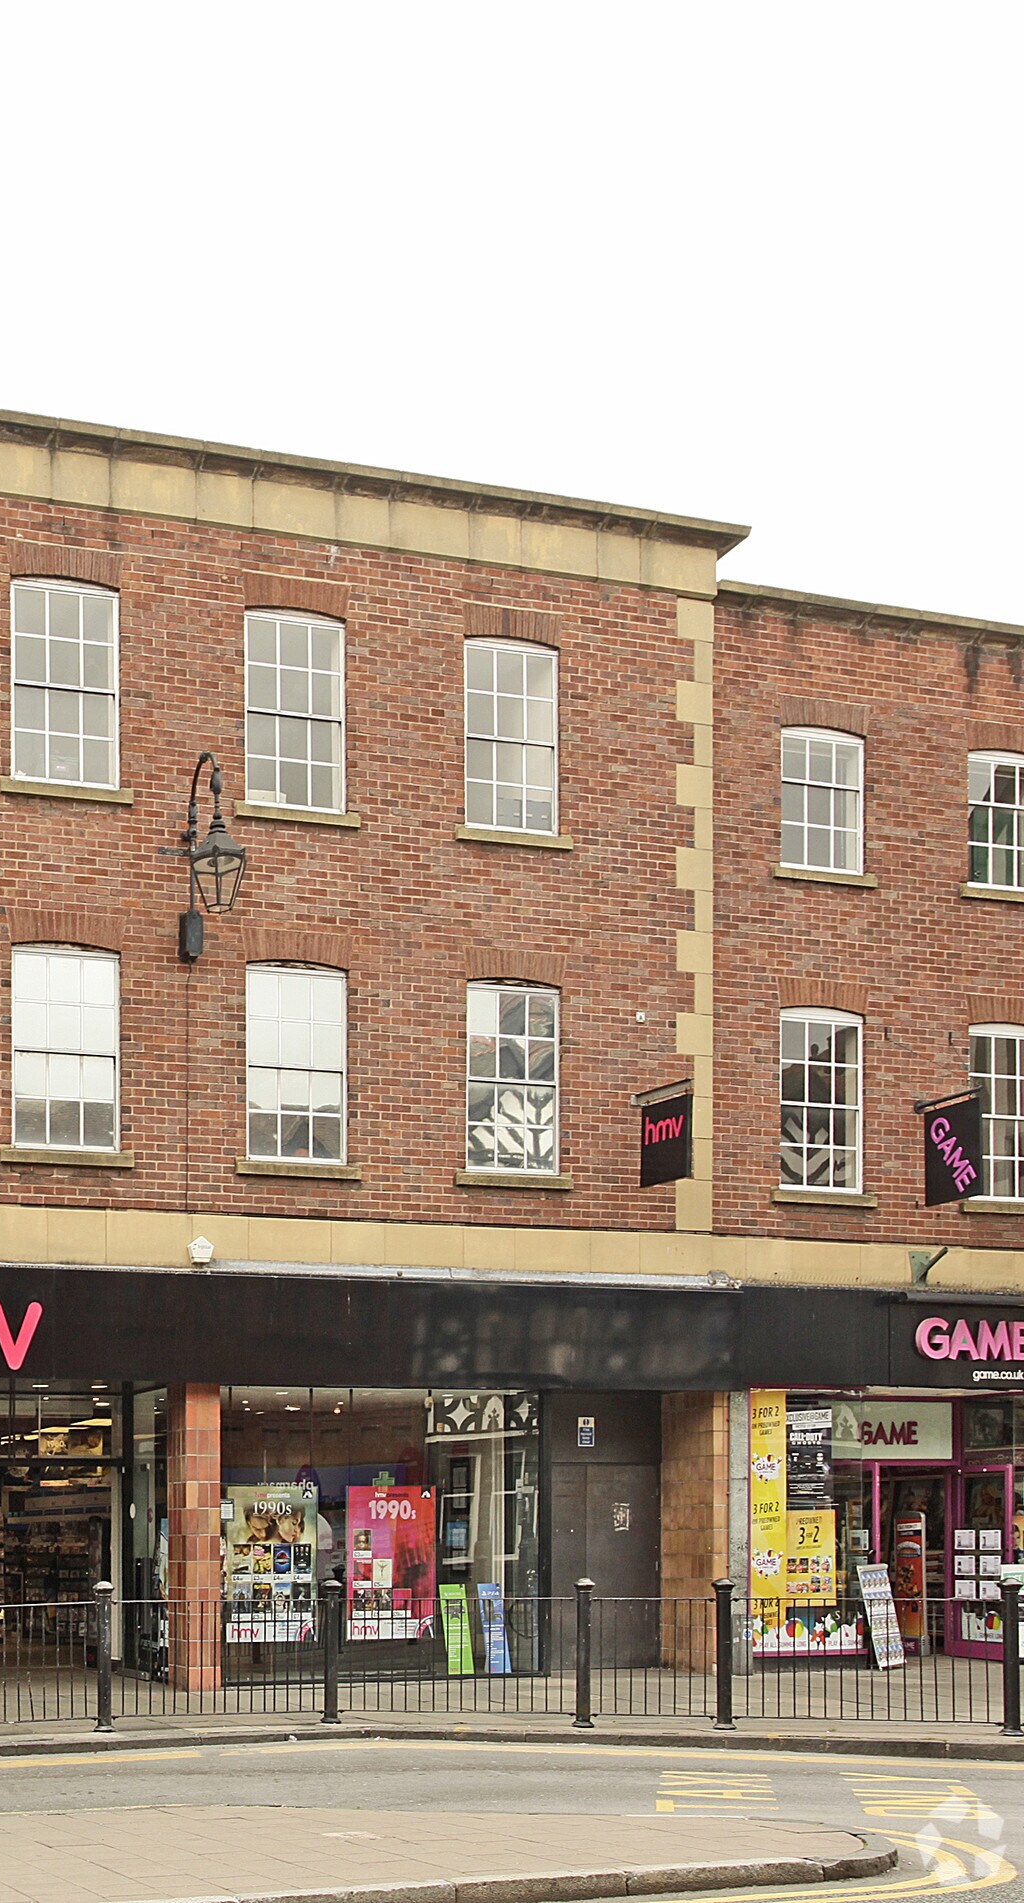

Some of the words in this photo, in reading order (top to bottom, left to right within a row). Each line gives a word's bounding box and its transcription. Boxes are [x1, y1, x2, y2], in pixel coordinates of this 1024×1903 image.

[645, 1114, 684, 1145] hmv
[930, 1117, 977, 1193] GAME
[915, 1317, 1024, 1360] GAME
[972, 1370, 1024, 1382] game.co.uk
[752, 1409, 757, 1419] 3
[759, 1407, 773, 1418] FOR
[775, 1406, 779, 1417] 2
[859, 1421, 919, 1445] GAME
[756, 1463, 776, 1471] GAME
[253, 1501, 292, 1515] 1990s
[368, 1500, 416, 1520] 1990s
[753, 1504, 757, 1515] 3
[759, 1502, 774, 1513] FOR
[775, 1501, 779, 1512] 2
[798, 1527, 806, 1544] 3
[813, 1526, 820, 1543] 2
[756, 1558, 776, 1566] GAME
[231, 1624, 260, 1638] hmv
[352, 1622, 379, 1635] hmv
[655, 1771, 779, 1812] TAXI
[839, 1772, 999, 1820] ONLY
